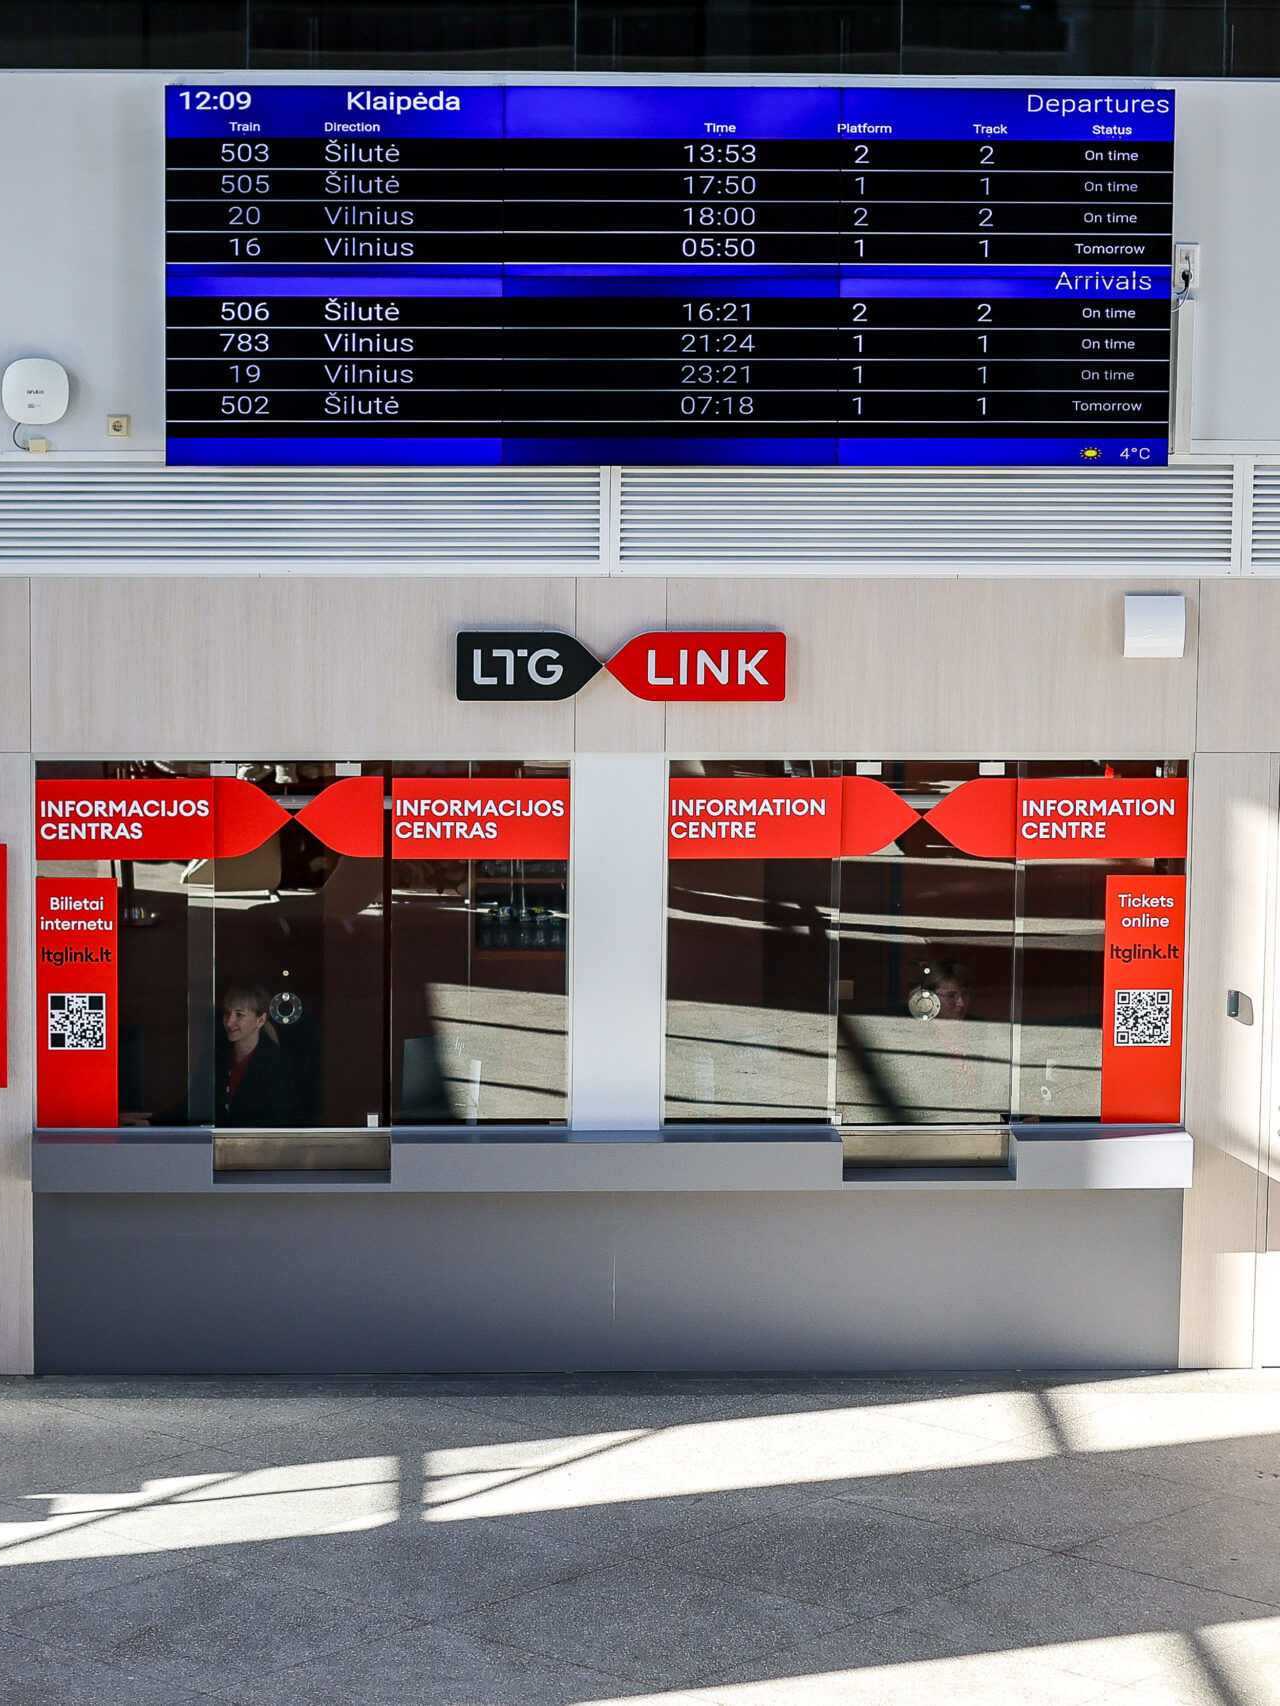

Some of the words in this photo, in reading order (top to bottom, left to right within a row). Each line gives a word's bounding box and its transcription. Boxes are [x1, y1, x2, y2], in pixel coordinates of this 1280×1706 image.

[180, 92, 251, 110] 12:09
[348, 91, 460, 114] Klaipėda
[1028, 95, 1169, 116] Departures
[229, 122, 260, 131] Train
[325, 122, 380, 131] Direction
[703, 122, 737, 133] Time
[838, 123, 892, 133] Platform
[973, 124, 1007, 134] Track
[1093, 125, 1132, 135] Status
[221, 144, 269, 162] 503
[325, 139, 399, 162] Šilutė
[684, 144, 755, 162] 13:53
[854, 144, 870, 164] 2
[979, 145, 995, 165] 2
[1084, 149, 1104, 161] On
[1107, 149, 1139, 162] time
[221, 175, 269, 193] 505
[325, 171, 399, 193] Šilutė
[684, 176, 755, 194] 17:50
[855, 176, 865, 195] 1
[980, 177, 990, 196] 1
[1084, 181, 1103, 192] On
[1106, 181, 1138, 193] time
[229, 207, 260, 224] 20
[325, 206, 413, 225] Vilnius
[684, 207, 755, 225] 18:00
[853, 207, 869, 227] 2
[978, 207, 994, 227] 2
[1083, 212, 1103, 223] On
[1106, 212, 1138, 224] time
[230, 238, 260, 256] 16
[325, 238, 413, 256] Vilnius
[683, 238, 754, 257] 05:50
[854, 238, 864, 258] 1
[978, 239, 989, 258] 1
[1074, 243, 1146, 255] Tomorrow
[1055, 272, 1152, 291] Arrivals
[221, 302, 269, 320] 506
[325, 298, 399, 321] Šilutė
[683, 303, 749, 321] 16:21
[852, 302, 868, 322] 2
[977, 303, 993, 323] 2
[1082, 307, 1101, 319] On
[1104, 307, 1136, 319] time
[220, 334, 268, 352] 783
[324, 333, 413, 352] Vilnius
[682, 334, 755, 352] 21:24
[852, 334, 863, 353] 1
[977, 334, 987, 353] 1
[1081, 338, 1101, 350] On
[1104, 338, 1136, 350] time
[230, 365, 260, 383] 19
[325, 364, 413, 383] Vilnius
[682, 365, 749, 383] 23:21
[852, 365, 862, 384] 1
[977, 365, 987, 384] 1
[1080, 369, 1100, 381] On
[1103, 369, 1135, 381] time
[221, 396, 269, 414] 502
[325, 392, 398, 414] Šilutė
[681, 397, 753, 414] 07:18
[852, 396, 862, 415] 1
[976, 396, 986, 416] 1
[1071, 400, 1143, 412] Tomorrow
[1120, 448, 1150, 459] 4°C
[474, 649, 563, 685] LTG
[648, 649, 768, 685] LINK
[41, 800, 209, 817] INFORMACIJOS
[397, 799, 564, 816] INFORMACIJOS
[672, 799, 825, 816] INFORMATION
[1023, 799, 1174, 816] INFORMATION
[41, 822, 142, 840] CENTRAS
[396, 822, 497, 838] CENTRAS
[671, 822, 756, 838] CENTRE
[1022, 822, 1106, 839] CENTRE
[50, 897, 103, 910] Bilietai
[1118, 894, 1174, 907] Tickets
[41, 917, 112, 930] internetu
[1122, 914, 1169, 927] online
[42, 947, 111, 966] ltglink.lt
[1111, 944, 1179, 963] ltglink.lt
